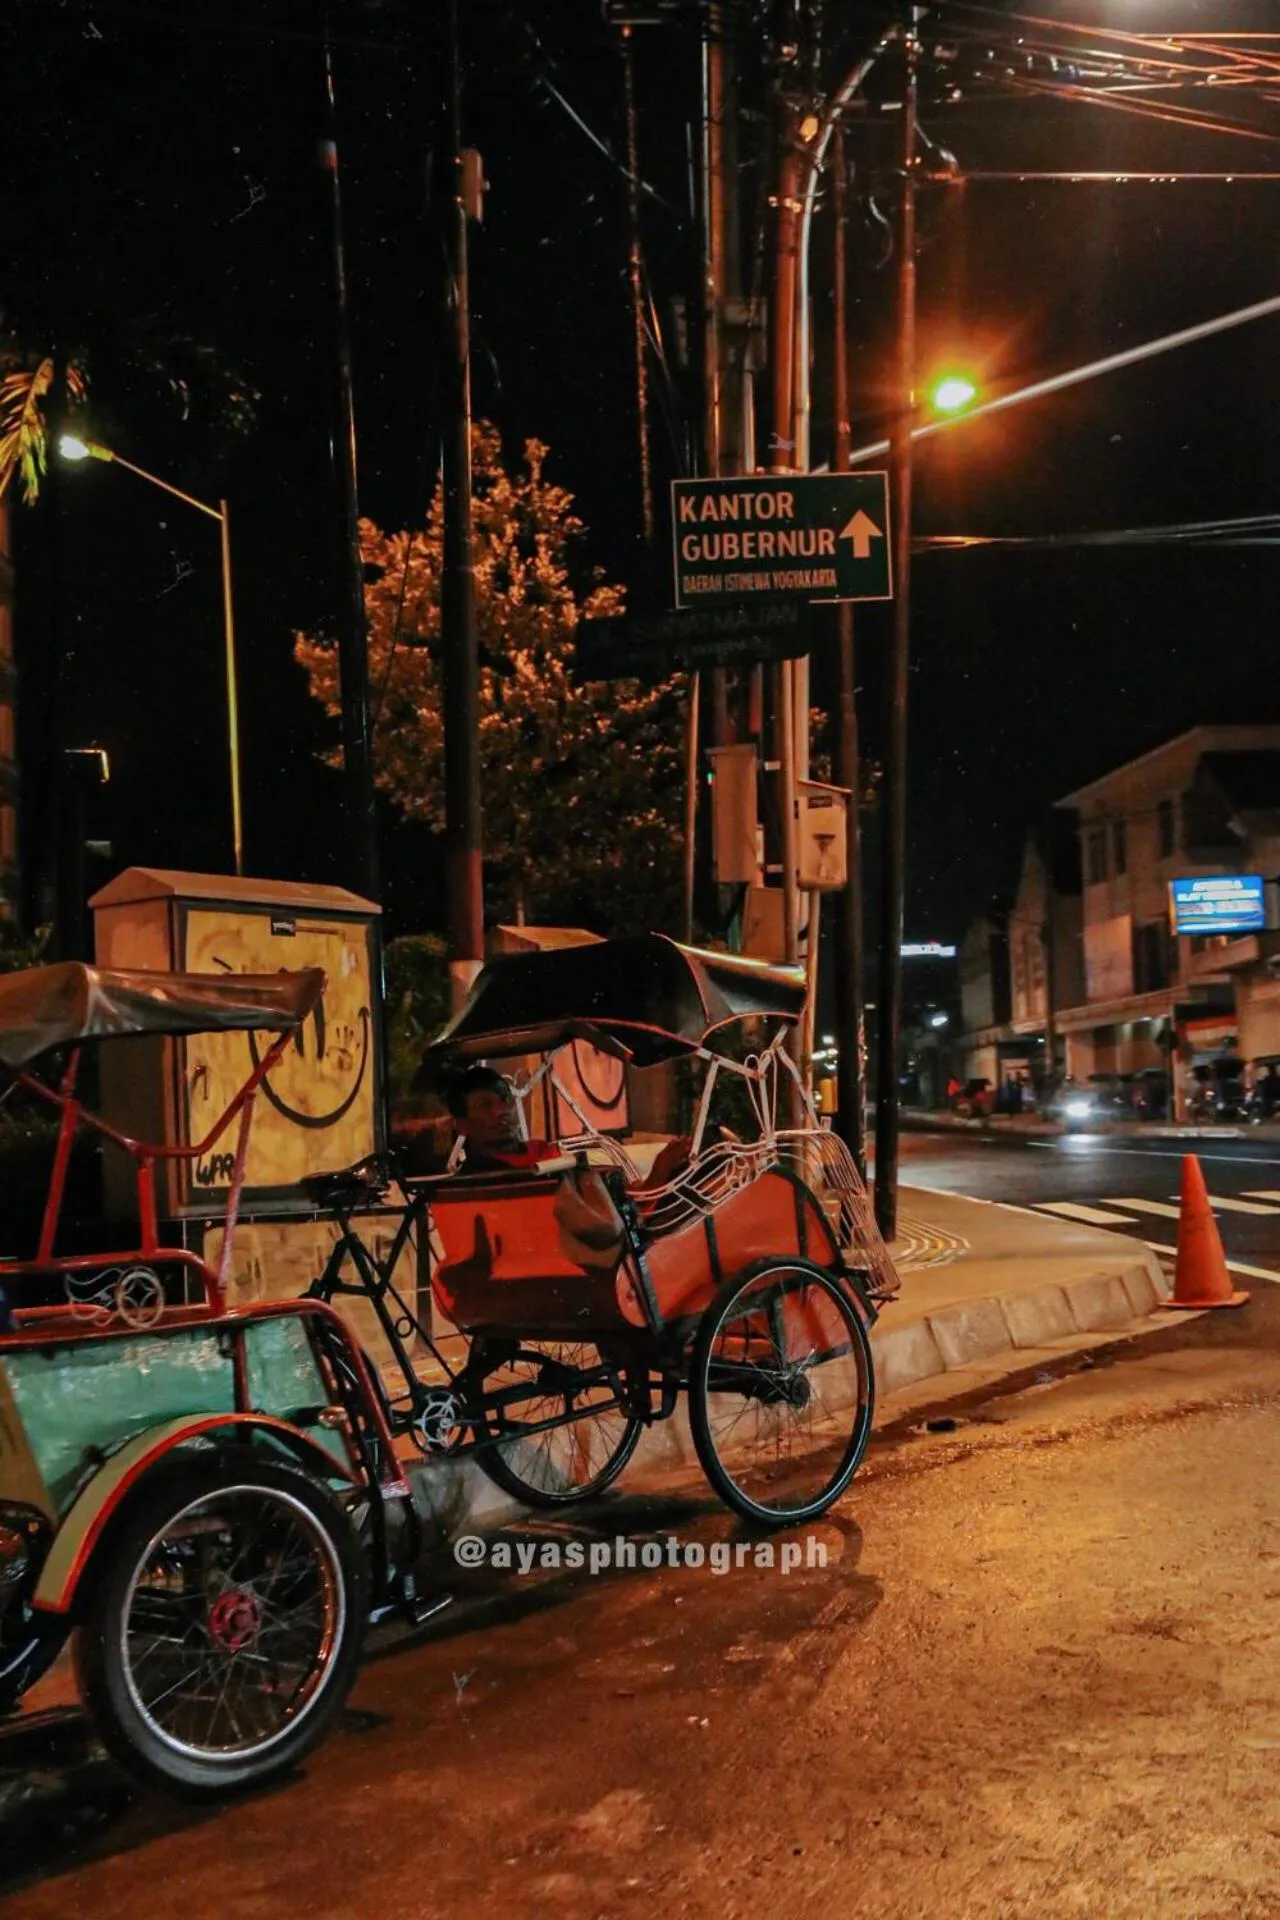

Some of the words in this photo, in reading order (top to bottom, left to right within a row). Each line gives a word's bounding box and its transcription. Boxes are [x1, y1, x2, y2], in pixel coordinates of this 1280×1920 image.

[679, 491, 795, 523] KANTOR
[681, 528, 836, 562] GUBERNUR
[682, 575, 722, 594] DAERAH
[725, 571, 768, 592] ISTIMEWA
[771, 567, 838, 588] YOGYAKARTA
